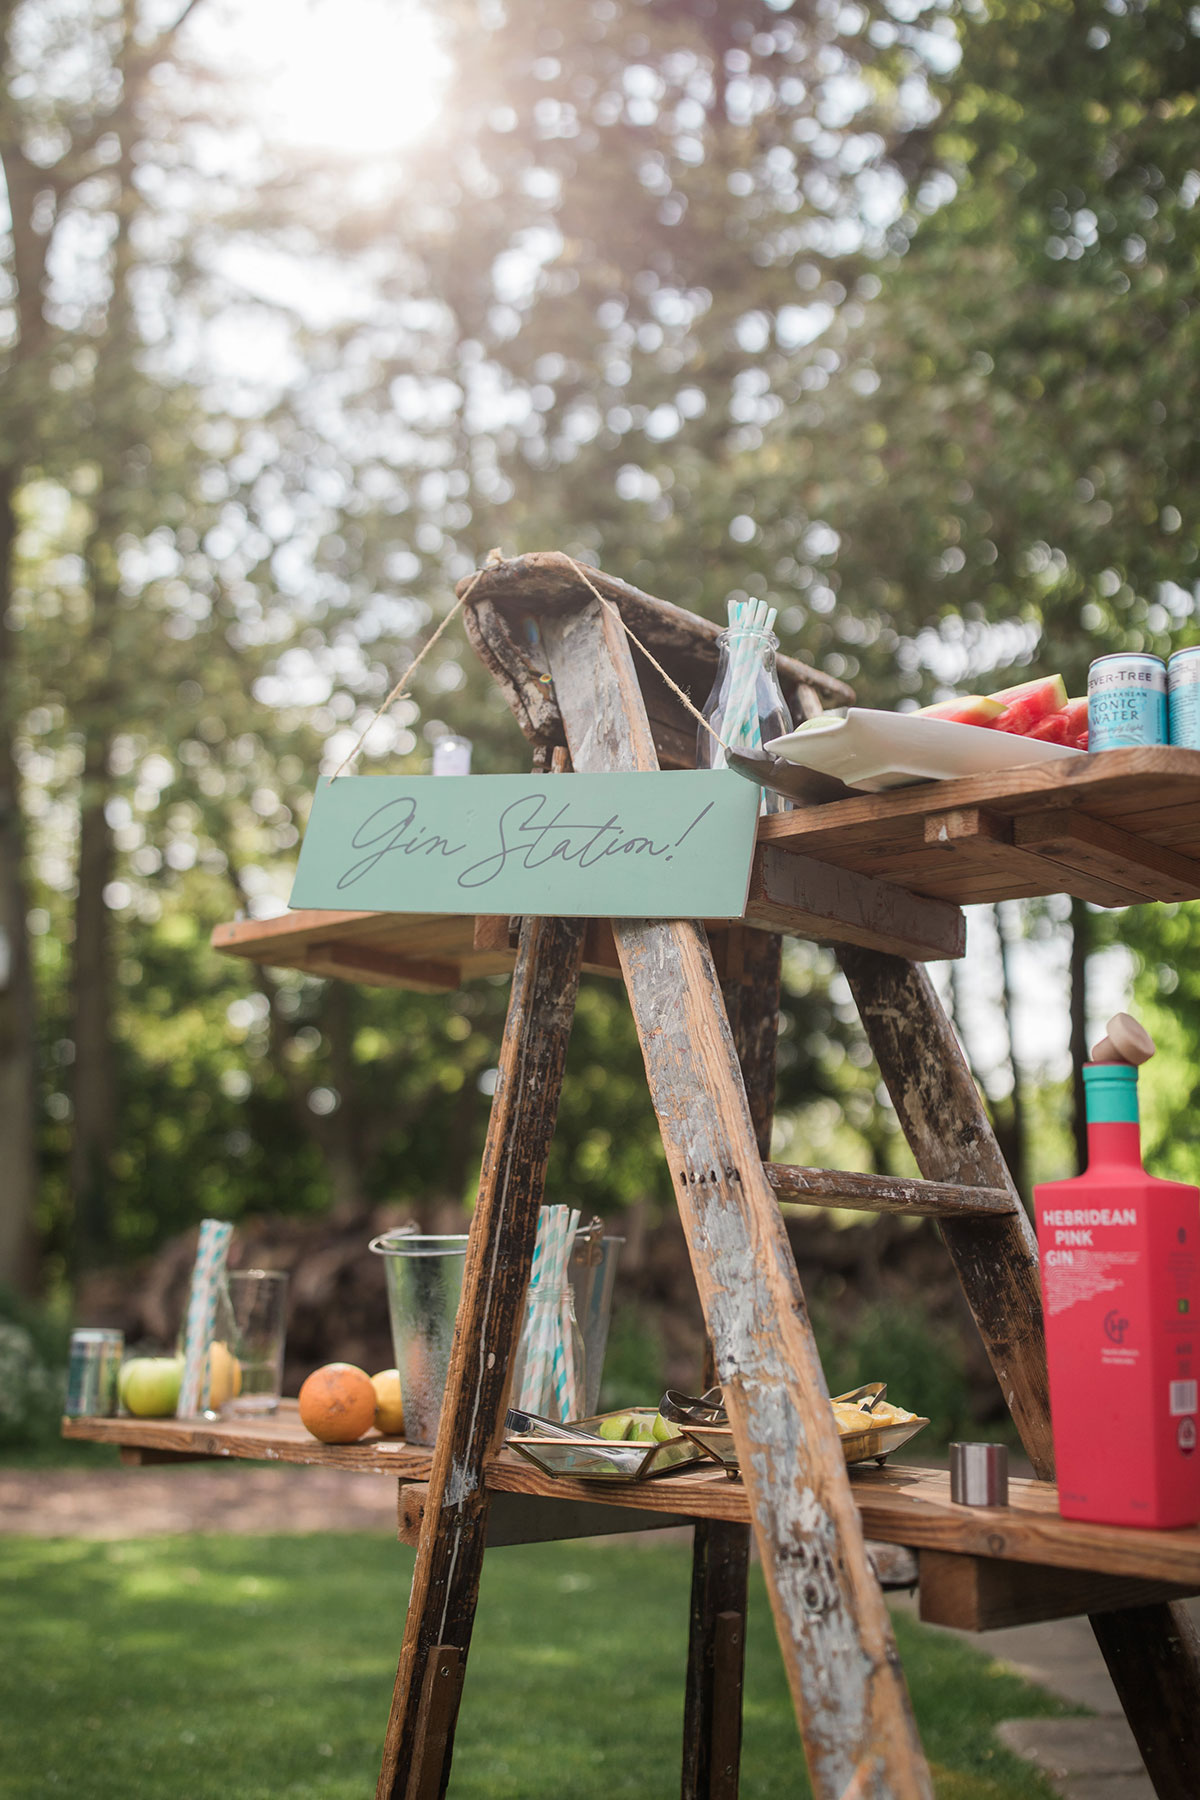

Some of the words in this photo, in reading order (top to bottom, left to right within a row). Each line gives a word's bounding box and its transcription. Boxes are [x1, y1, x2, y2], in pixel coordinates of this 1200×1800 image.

[1093, 698, 1137, 714] TONIC
[1092, 710, 1140, 726] WATER
[336, 796, 466, 890] Gin
[457, 793, 715, 888] Station!
[1043, 1208, 1137, 1226] HEBRIDEAN
[1055, 1229, 1093, 1246] PINK
[1046, 1250, 1073, 1266] GIN
